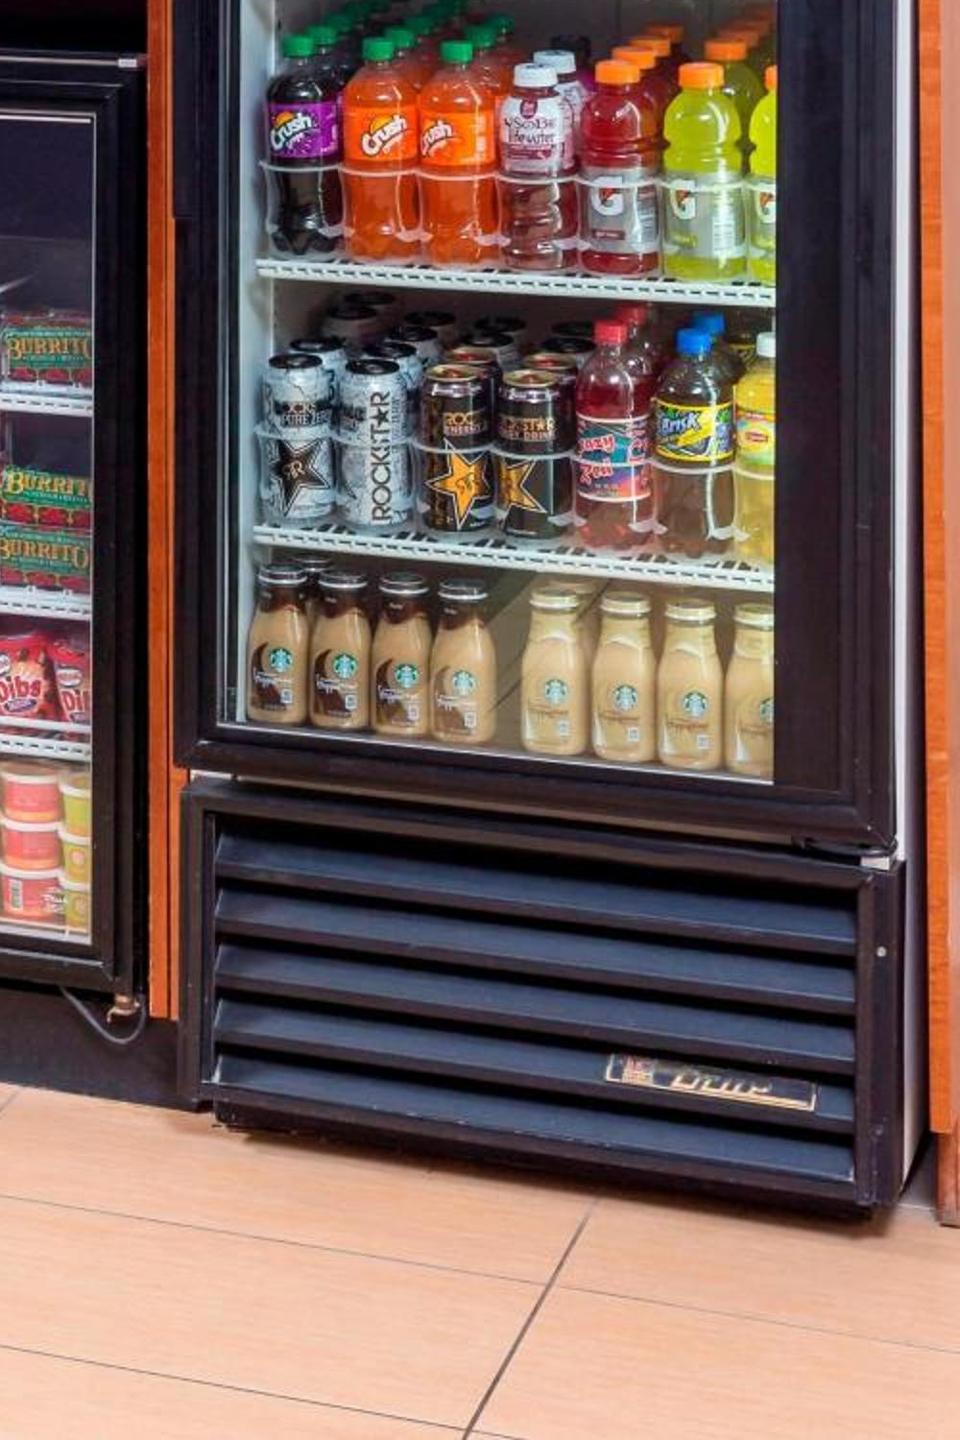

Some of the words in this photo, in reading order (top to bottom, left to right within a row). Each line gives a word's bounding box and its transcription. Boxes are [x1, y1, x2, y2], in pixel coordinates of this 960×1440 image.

[269, 112, 313, 151] Crush
[361, 114, 408, 156] Crush
[660, 411, 701, 435] Brisk
[6, 471, 87, 496] BURRIT
[60, 690, 90, 710] Di
